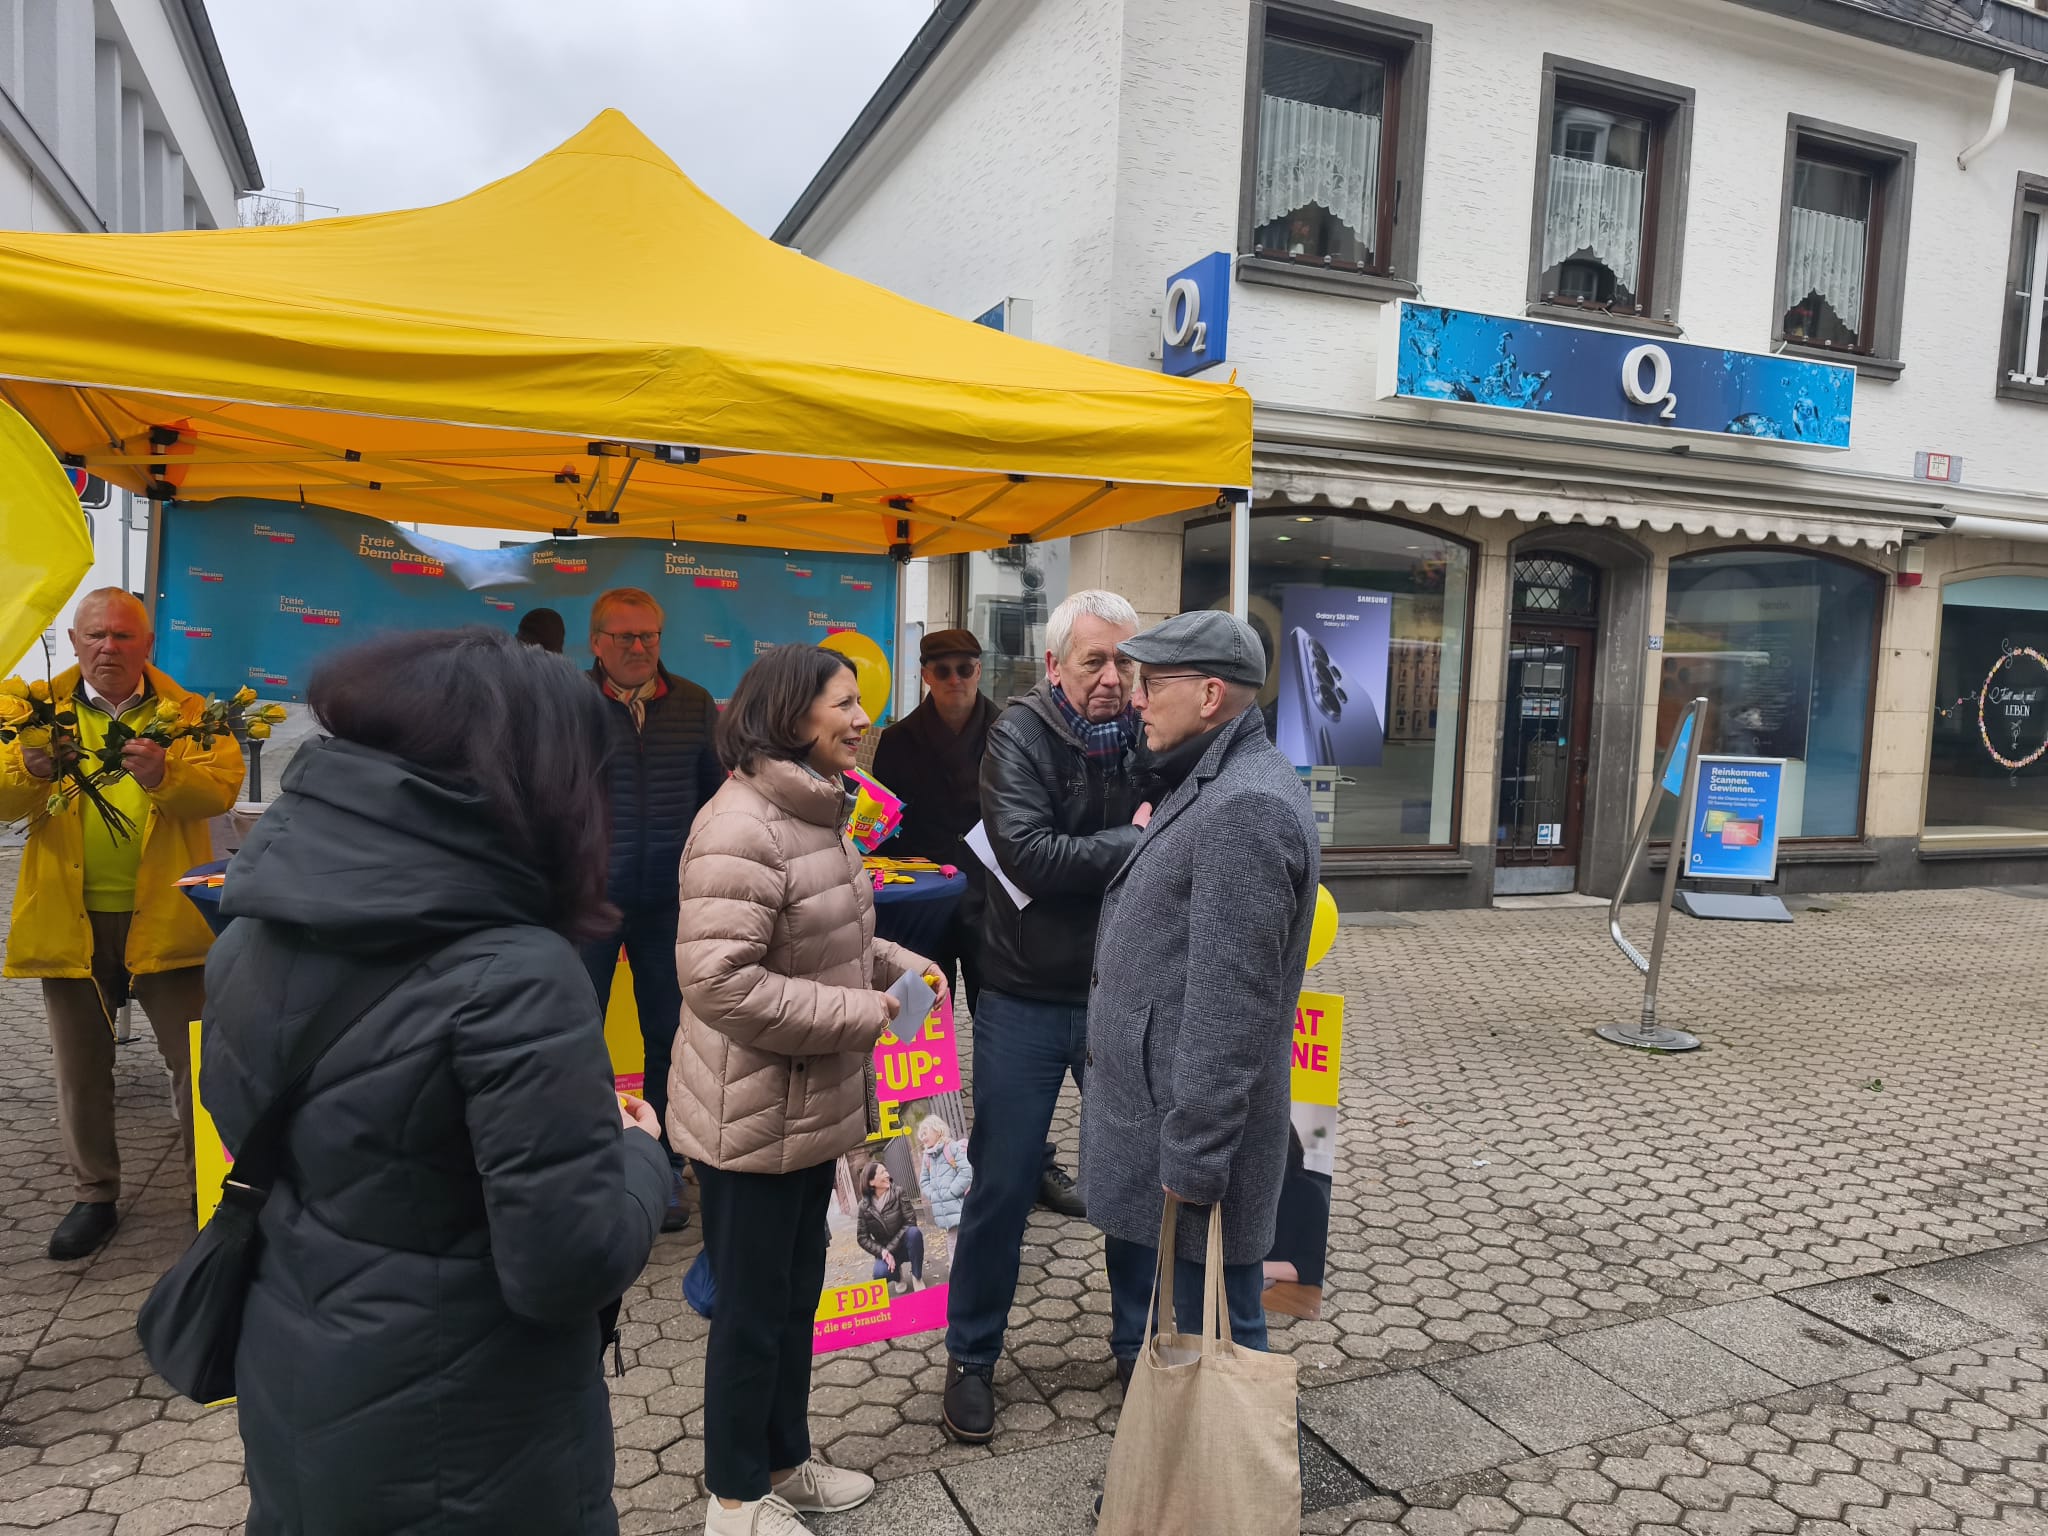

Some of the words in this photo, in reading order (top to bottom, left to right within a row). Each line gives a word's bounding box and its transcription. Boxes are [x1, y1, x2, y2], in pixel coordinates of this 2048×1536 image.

[1162, 278, 1207, 354] O2
[1621, 344, 1678, 420] O2
[360, 534, 395, 548] Freie
[359, 545, 444, 566] Demokraten
[665, 552, 696, 564] Freie
[422, 566, 443, 575] FDP
[665, 563, 739, 578] Demokraten
[720, 580, 738, 588] FDP
[280, 595, 304, 605] Freie
[1357, 595, 1388, 604] SAMSUNG
[280, 603, 340, 617] Demokraten
[1315, 612, 1335, 621] Galaxy
[808, 618, 857, 628] Demokraten
[1711, 767, 1770, 778] Reinkommen.
[1710, 775, 1750, 785] Scannen.
[1709, 784, 1756, 794] Gewinnen.
[836, 1284, 884, 1313] FDP
[824, 1322, 839, 1334] die
[841, 1321, 853, 1330] es
[854, 1311, 892, 1328] braucht
